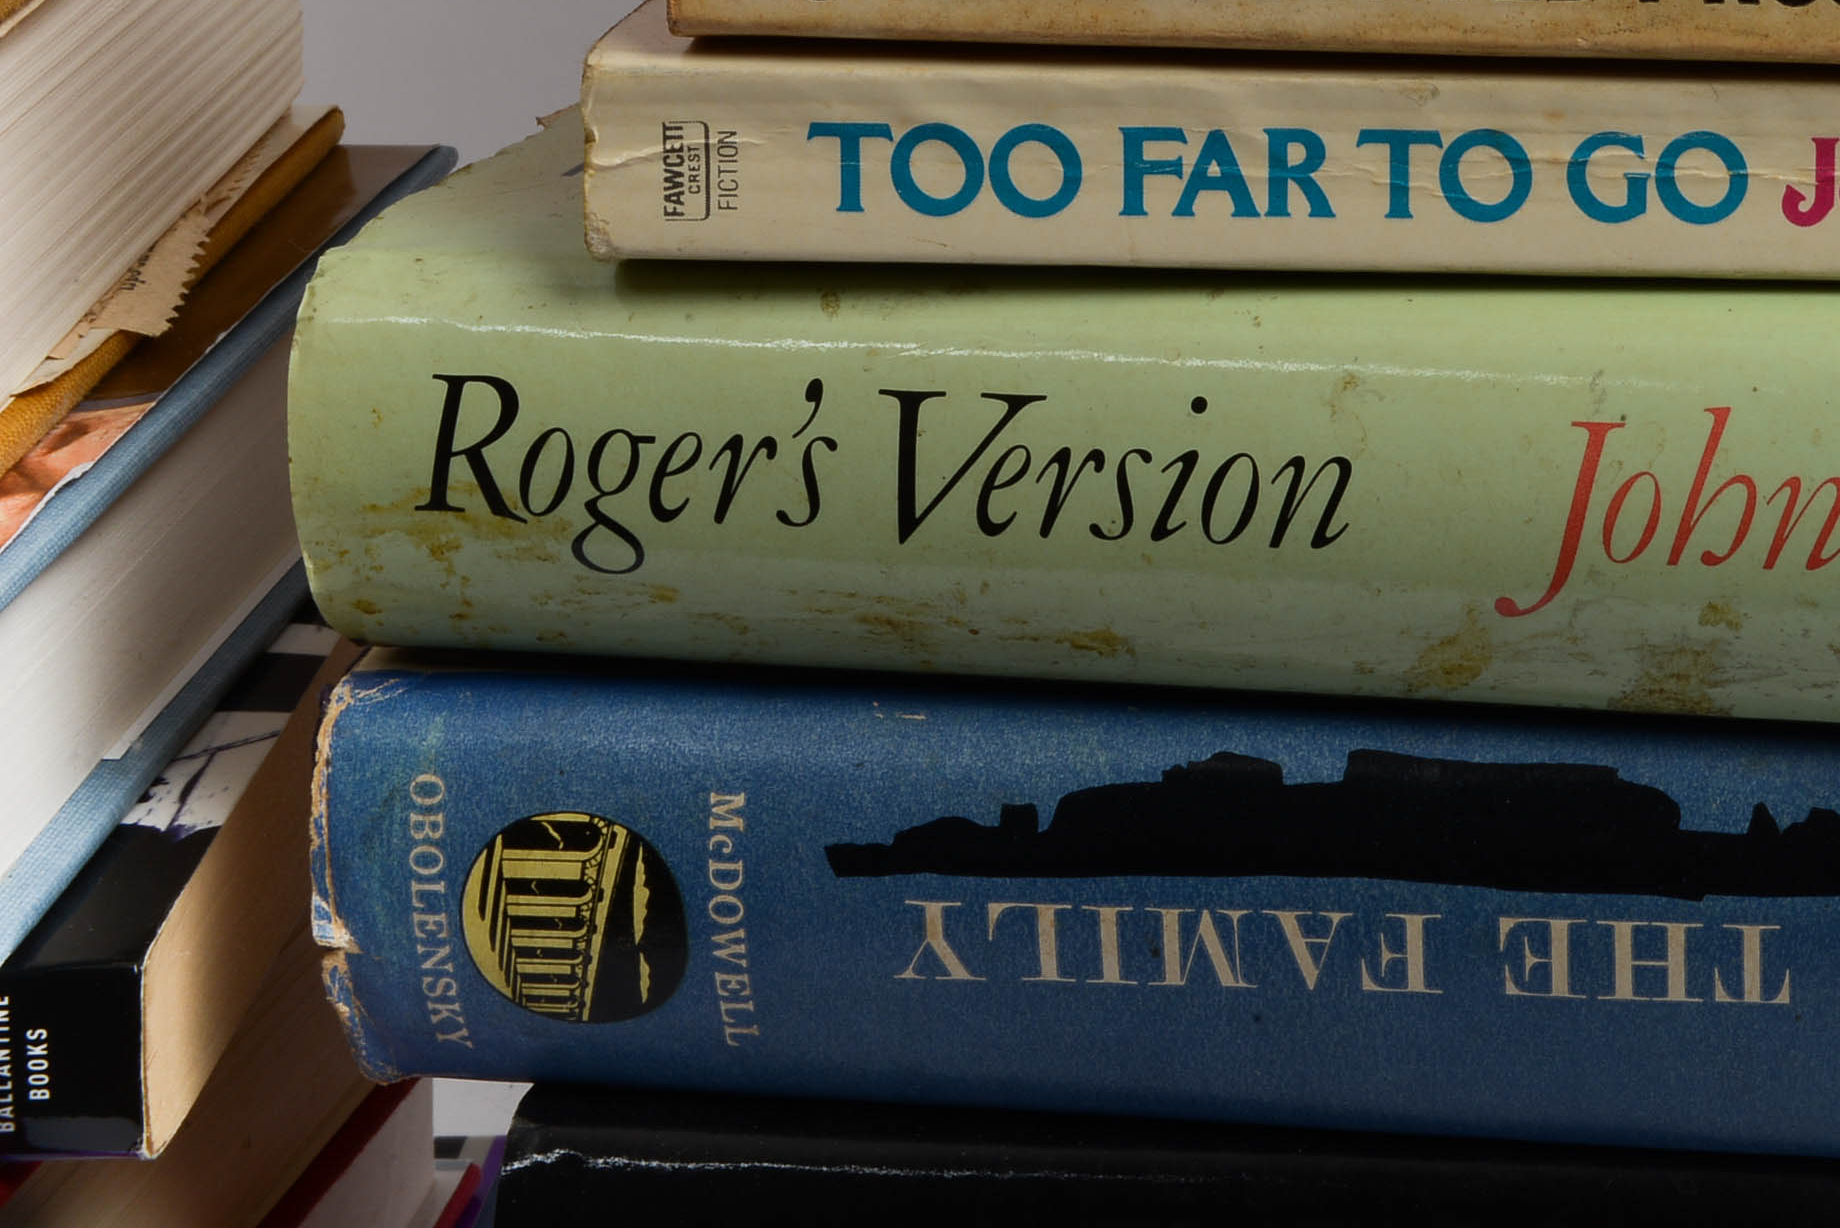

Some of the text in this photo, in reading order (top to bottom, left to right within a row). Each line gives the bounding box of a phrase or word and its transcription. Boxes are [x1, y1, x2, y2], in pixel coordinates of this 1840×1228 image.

[662, 121, 685, 217] FAWCETT
[687, 146, 701, 194] CREST
[716, 130, 738, 210] FICTION
[807, 122, 1748, 224] TOO FAR TO GO
[414, 375, 1352, 574] Roger's Version
[408, 772, 473, 1049] OBOLENSKY
[708, 792, 758, 1045] McDOWELL
[894, 900, 1442, 993] FAMILY
[1499, 917, 1790, 1004] THE
[26, 1029, 49, 1099] BOOKS
